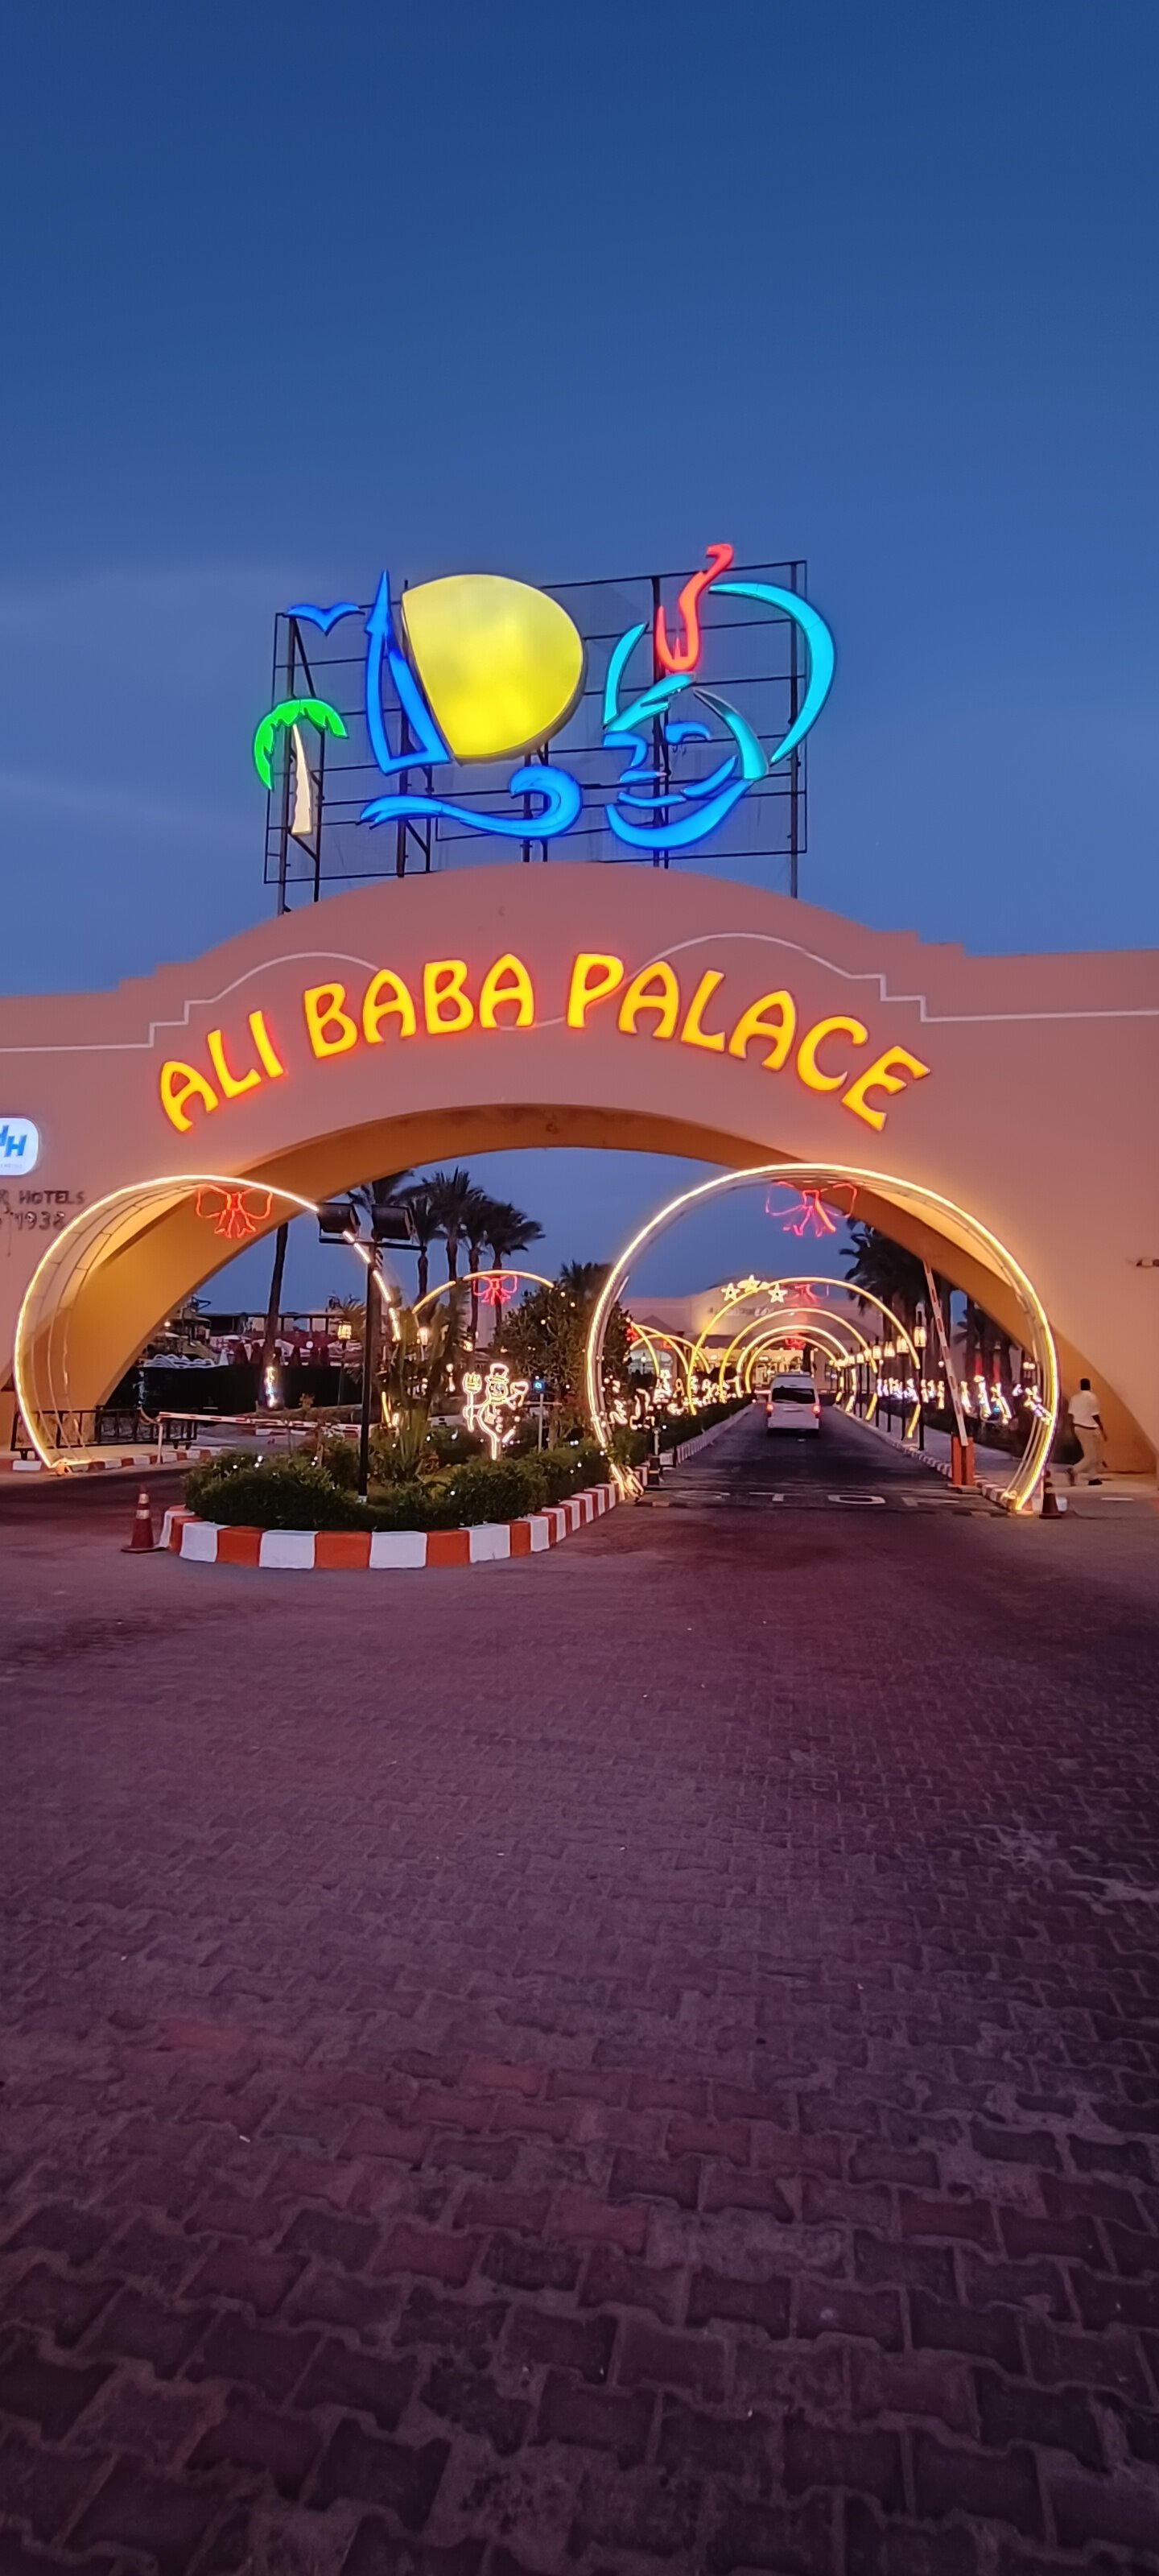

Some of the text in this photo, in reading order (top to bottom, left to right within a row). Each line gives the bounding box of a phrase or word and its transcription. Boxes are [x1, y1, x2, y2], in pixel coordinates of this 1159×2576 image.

[160, 952, 931, 1133] ALI BABA PALACE
[19, 1189, 86, 1206] HOTELS
